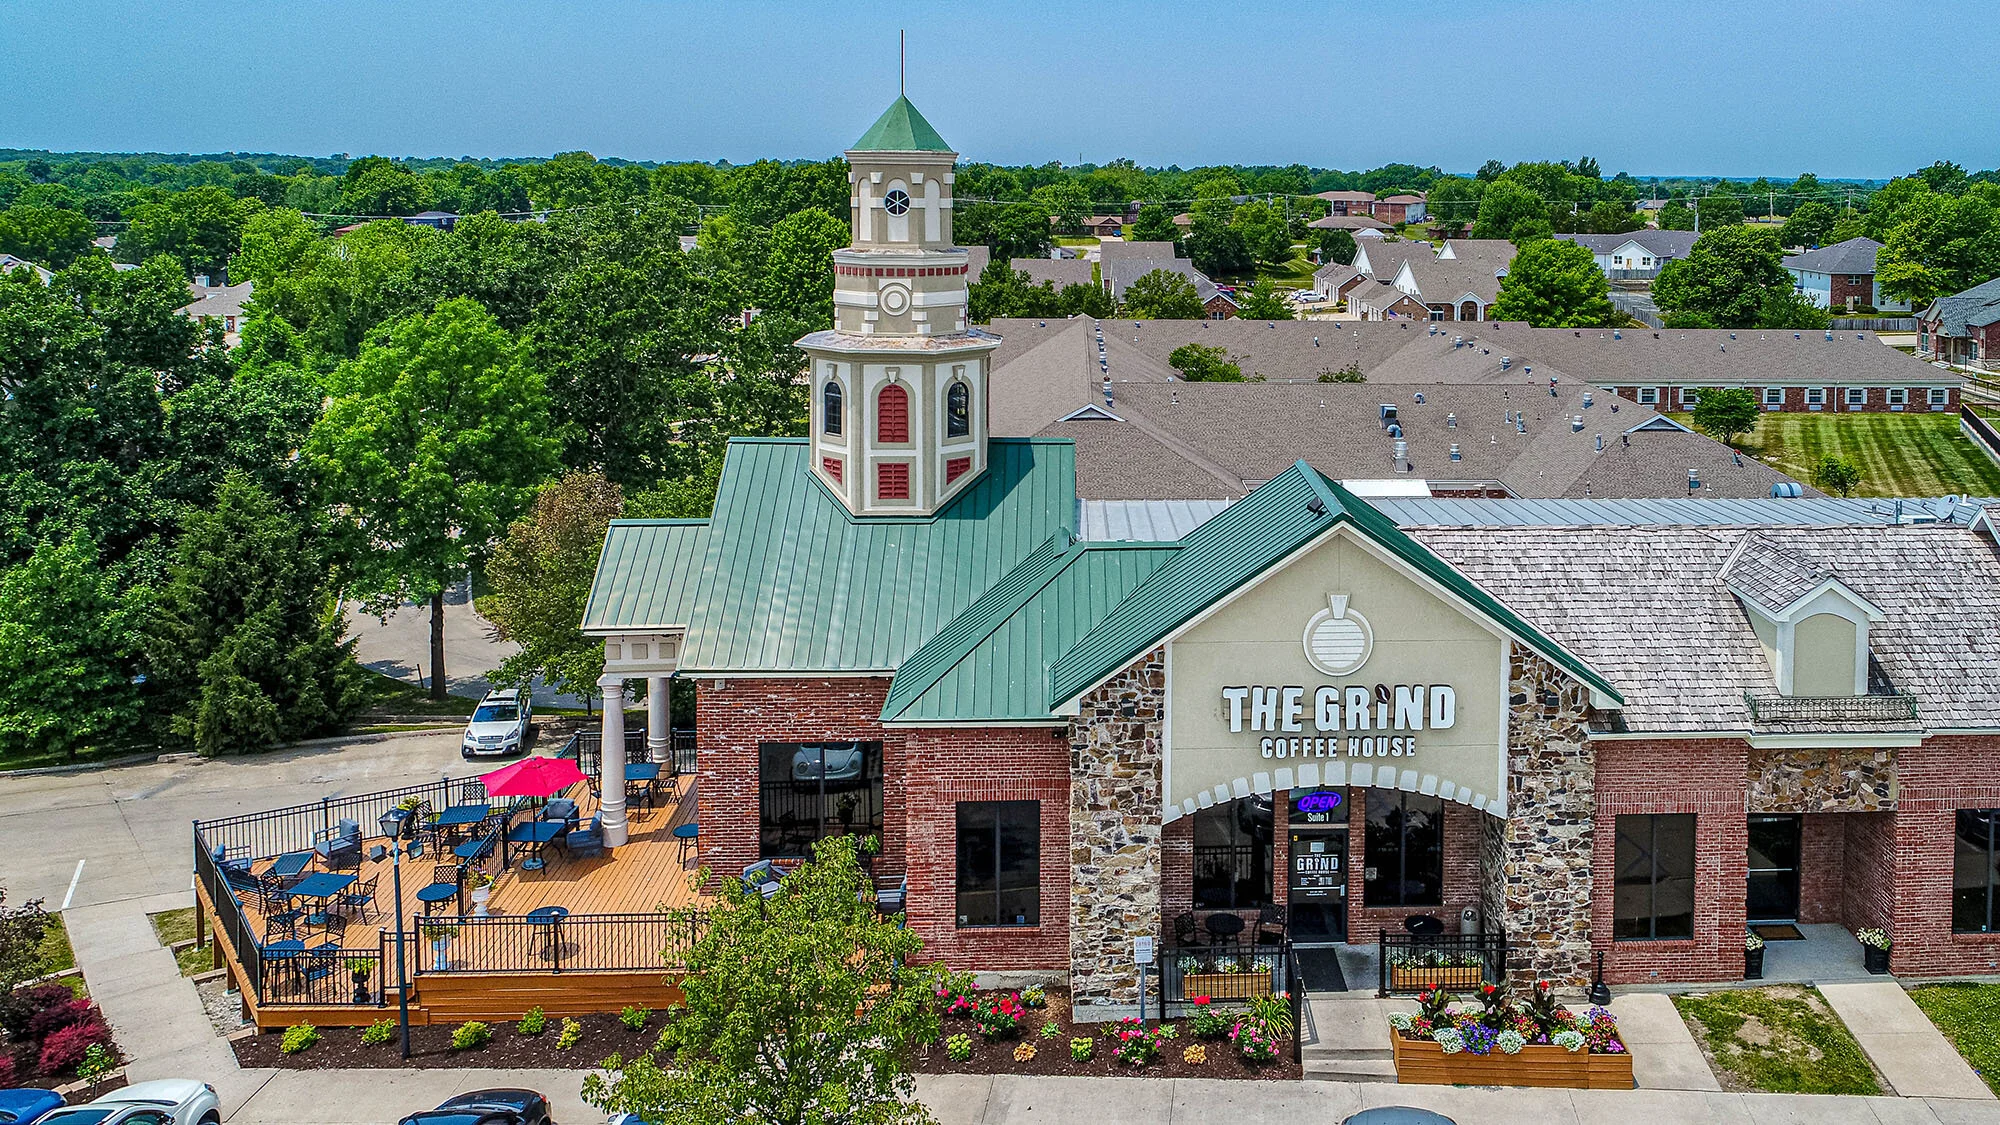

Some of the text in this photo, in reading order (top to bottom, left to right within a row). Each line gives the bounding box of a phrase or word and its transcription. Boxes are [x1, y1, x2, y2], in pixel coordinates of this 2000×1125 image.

[1222, 685, 1304, 733] THE
[1260, 735, 1416, 759] COFFEE HOUSE
[1301, 795, 1337, 809] OPEN
[1307, 812, 1329, 822] Suite 1
